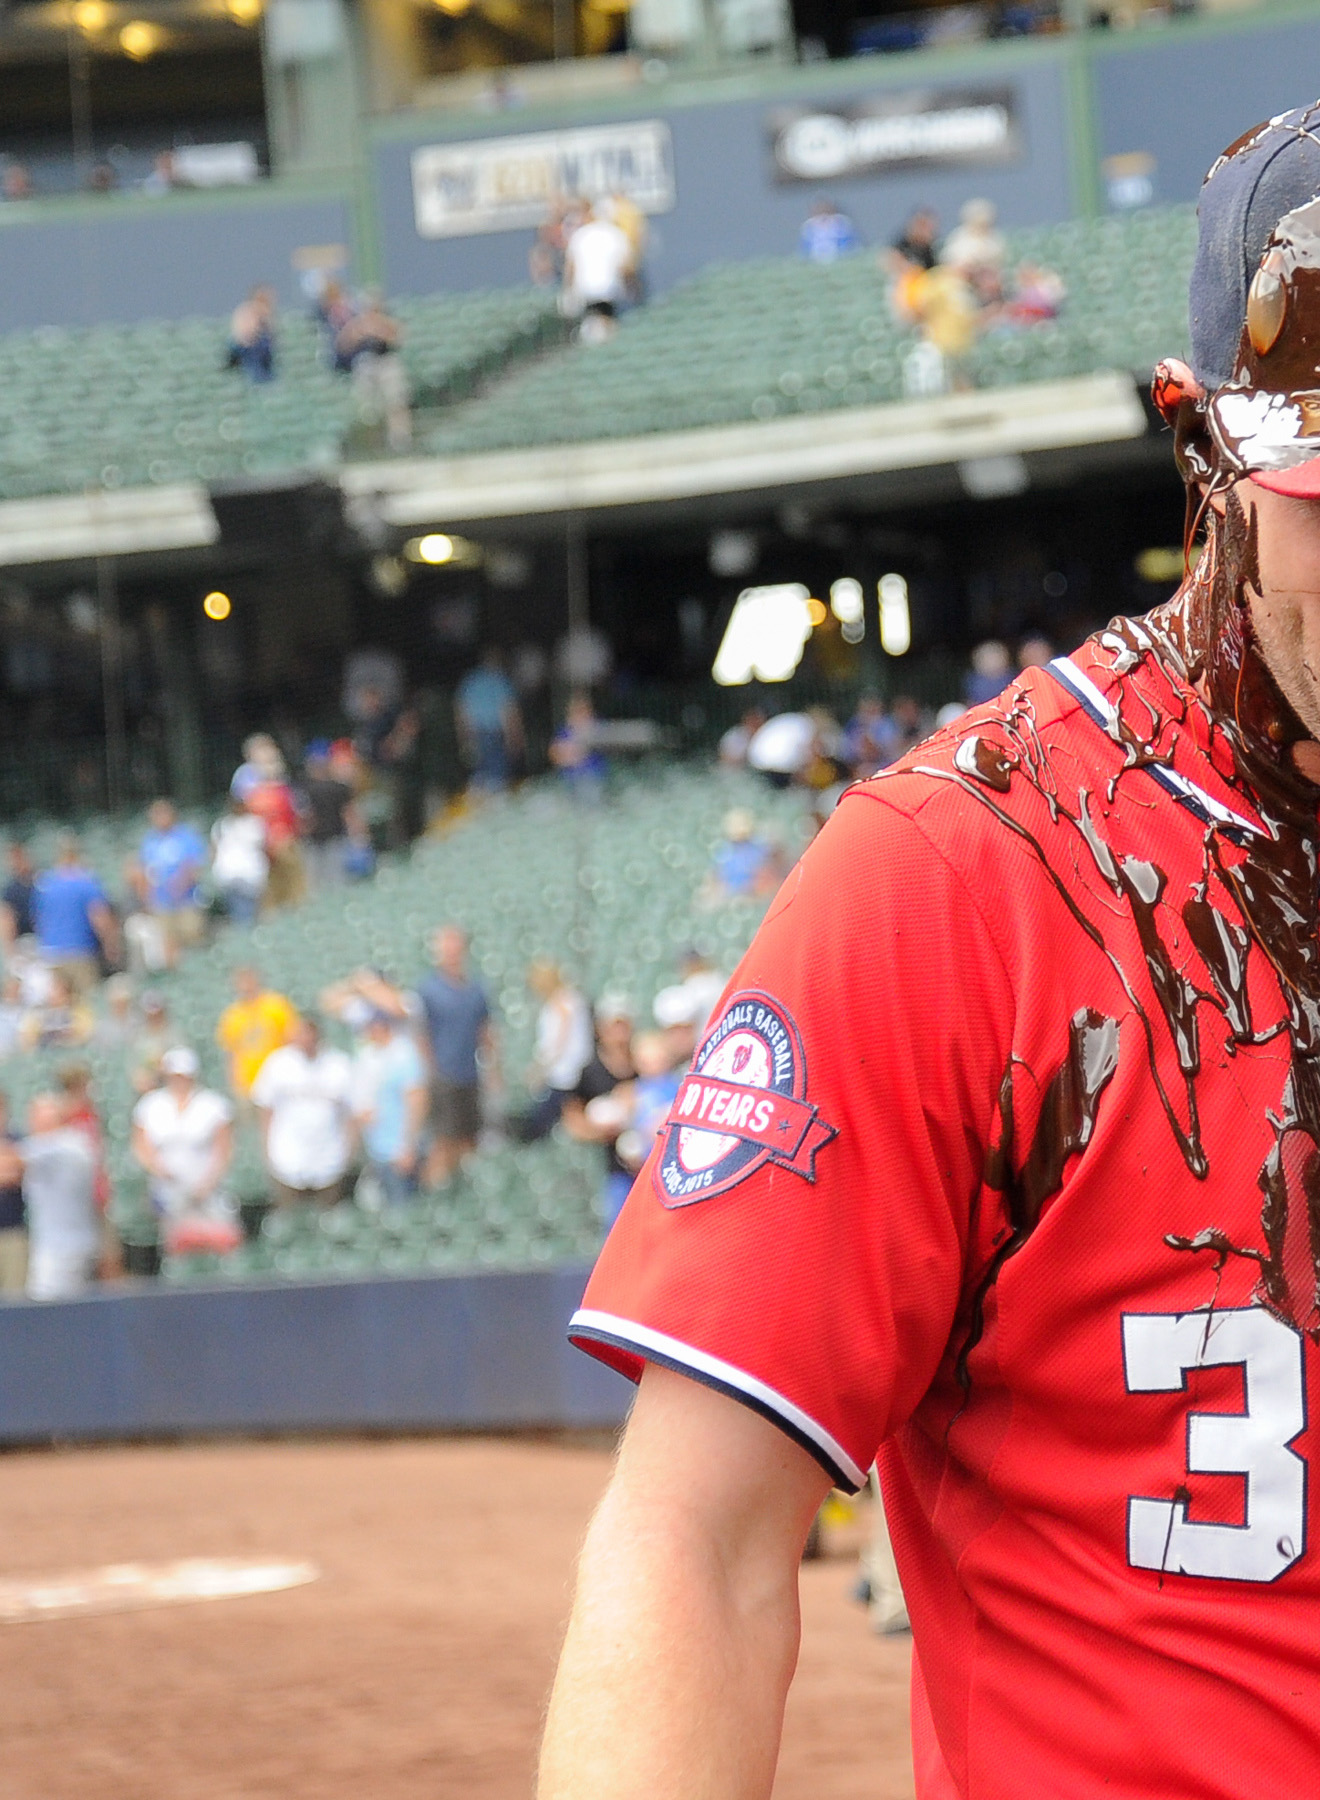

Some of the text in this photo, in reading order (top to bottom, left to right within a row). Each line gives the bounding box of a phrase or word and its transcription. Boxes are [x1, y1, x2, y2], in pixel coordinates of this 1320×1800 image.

[698, 1005, 792, 1086] NATIONALS BASEBALL
[678, 1083, 775, 1132] 10 YEARS
